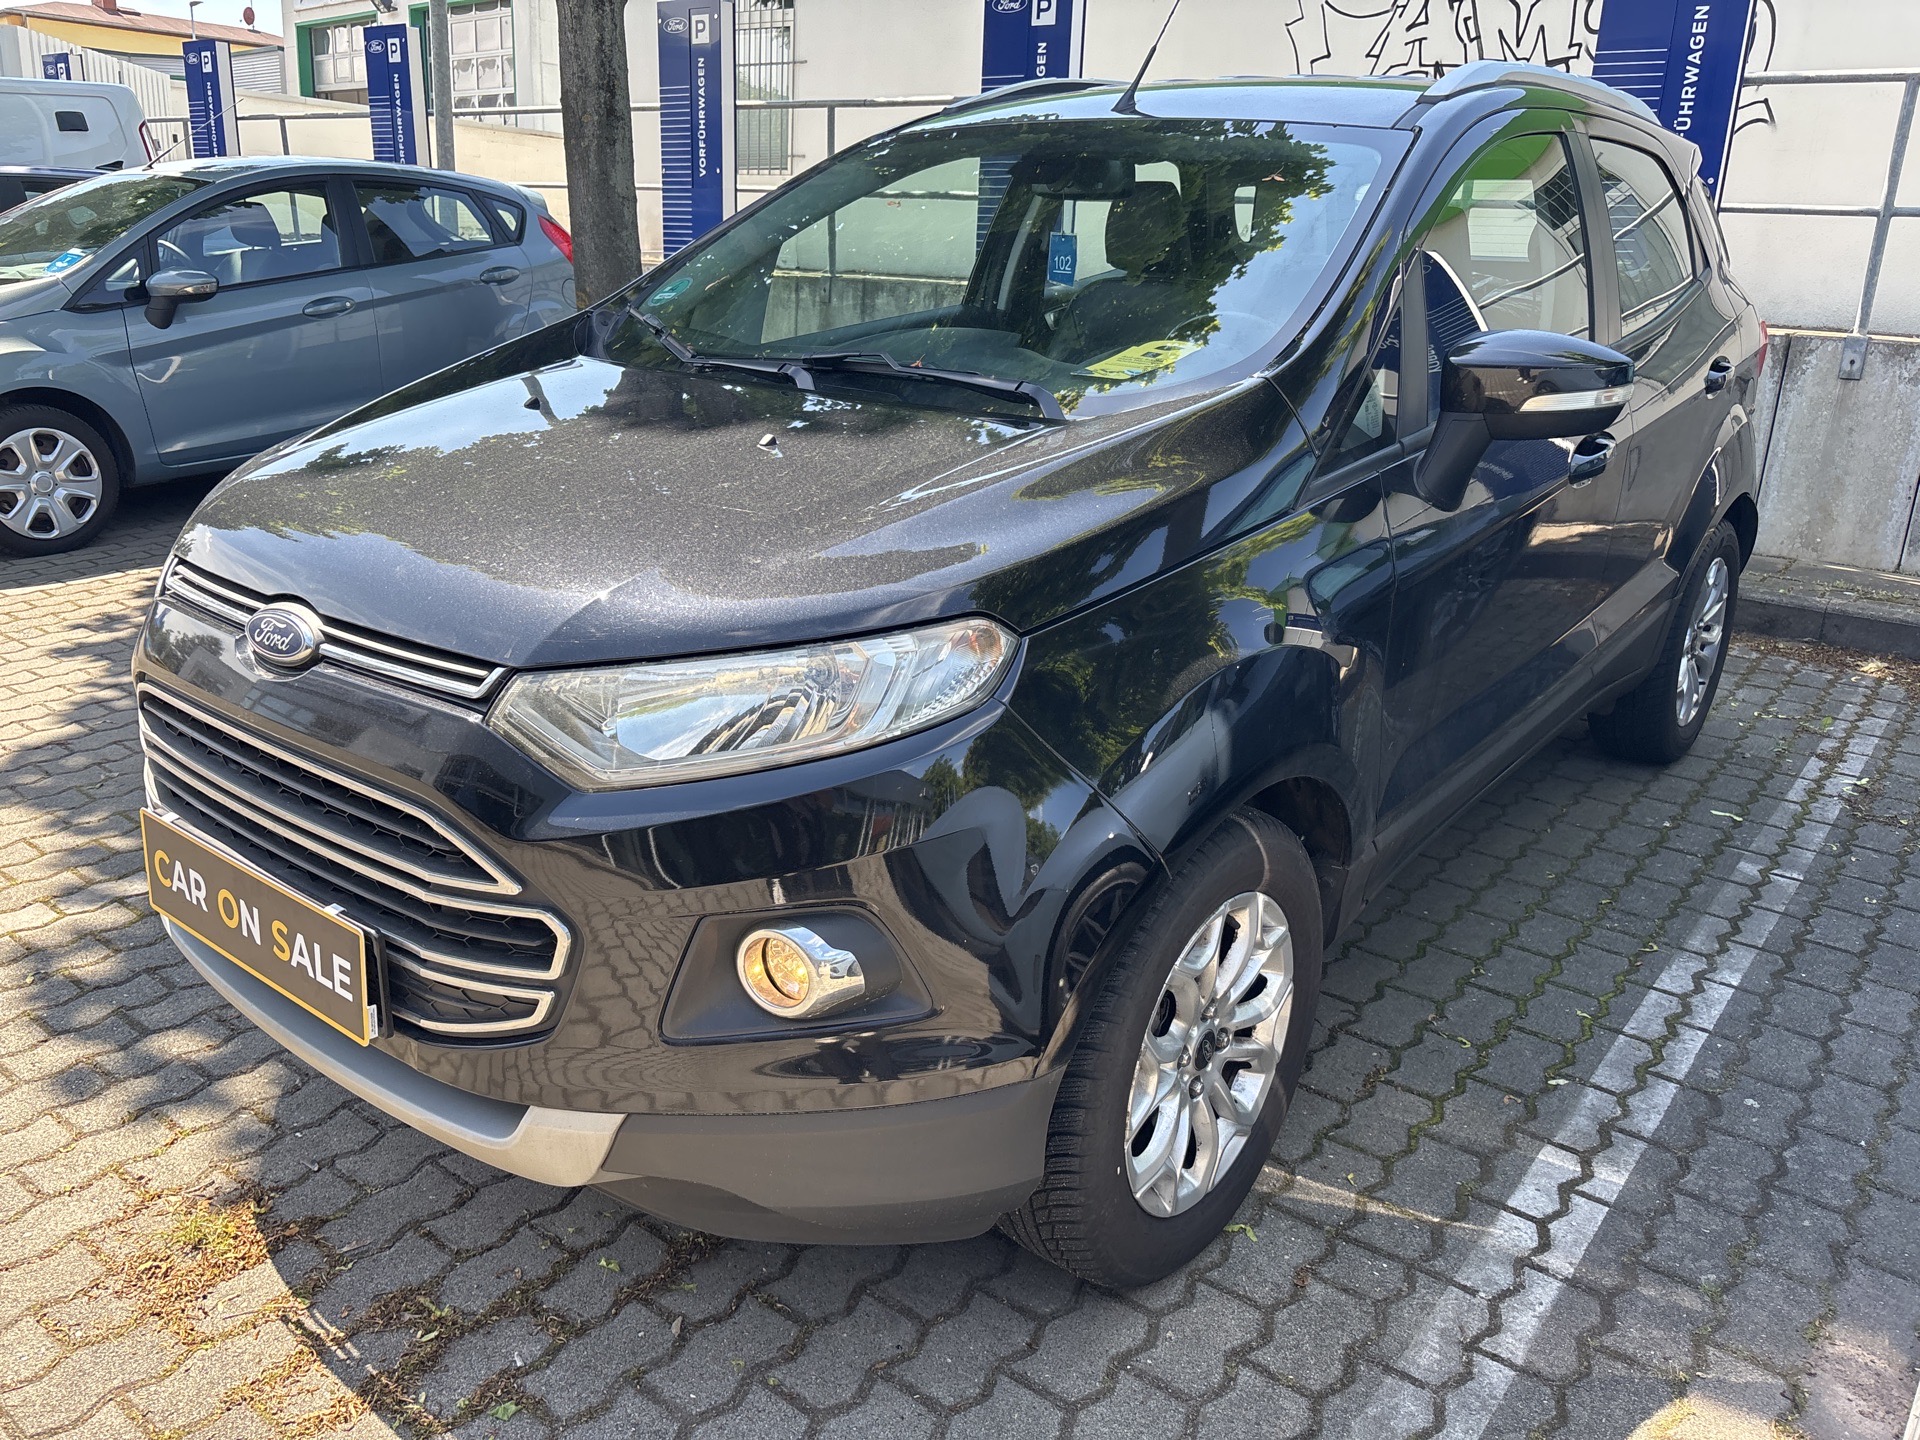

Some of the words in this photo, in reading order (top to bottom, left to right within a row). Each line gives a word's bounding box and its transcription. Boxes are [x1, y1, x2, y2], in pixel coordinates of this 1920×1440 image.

[1036, 0, 1052, 20] P
[667, 19, 684, 31] Ford
[695, 20, 706, 39] P
[390, 42, 398, 59] P
[203, 55, 210, 69] P
[1673, 5, 1710, 137] ÜHRWAGEN
[393, 73, 406, 164] ORFÜHRWAGEN
[698, 57, 707, 178] VORFÜHRWAGEN
[1054, 255, 1072, 271] 102
[254, 617, 295, 651] Ford
[154, 850, 208, 912] CAR
[217, 889, 261, 945] ON
[271, 920, 353, 1002] SALE
